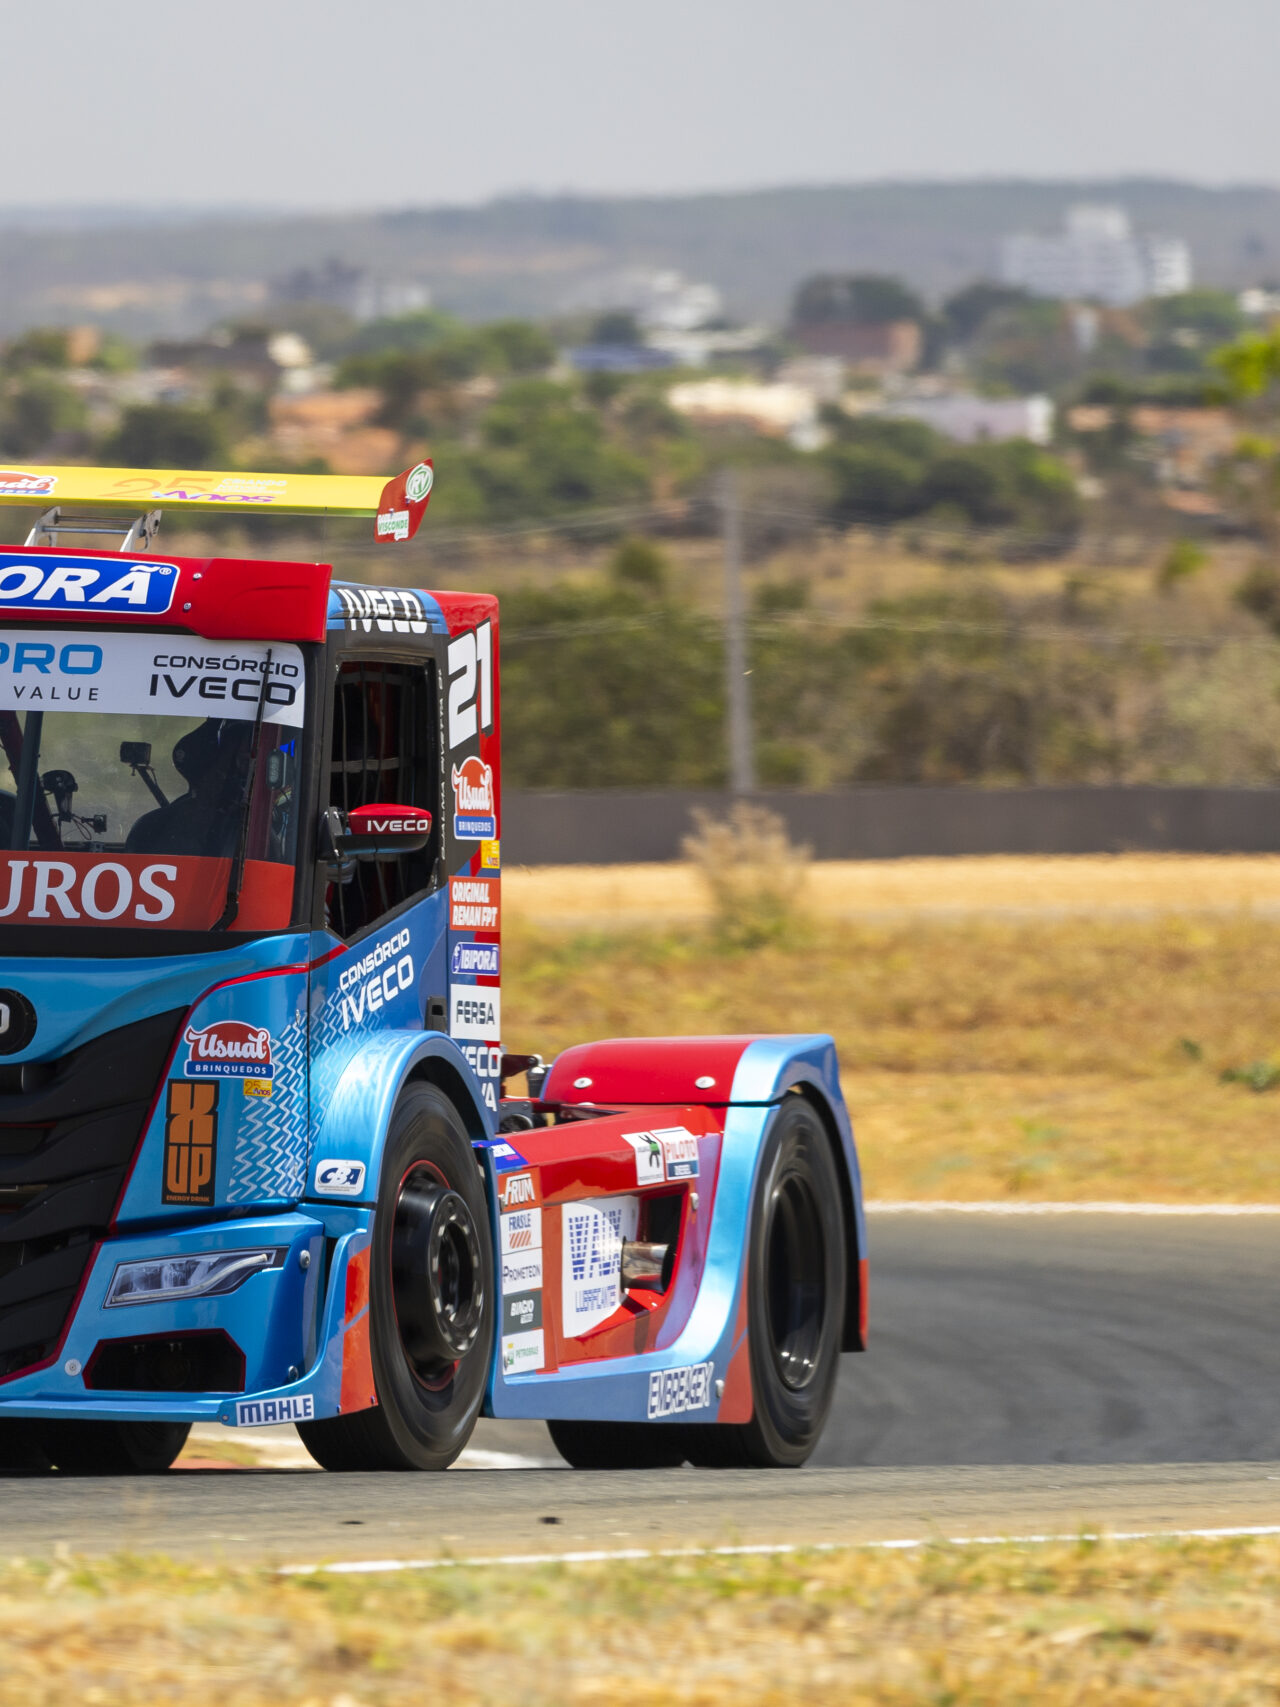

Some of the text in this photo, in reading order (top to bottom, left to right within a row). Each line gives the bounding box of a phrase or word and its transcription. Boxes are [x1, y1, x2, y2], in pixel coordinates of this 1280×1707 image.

[101, 477, 194, 499] 25
[338, 588, 428, 634] IVECO
[153, 655, 299, 678] CONSÓRCIO
[13, 685, 99, 701] VALUE
[149, 673, 297, 706] IVECO
[447, 620, 492, 751] 21
[453, 767, 491, 811] Usual
[367, 819, 428, 832] IVECO
[458, 821, 492, 834] BRINQUEDOS
[452, 881, 490, 904] ORIGINAL
[452, 904, 498, 927] REMAN FPT
[339, 927, 410, 990] CONSÓRCIO
[460, 946, 497, 971] IBIPORÃ
[341, 954, 414, 1032] IVECO
[456, 1000, 496, 1026] FERSA
[188, 1030, 267, 1060] Usual
[195, 1063, 267, 1075] BRINQUEDOS
[244, 1080, 261, 1094] 25
[166, 1145, 212, 1194] UP
[320, 1167, 362, 1186] CBA
[504, 1173, 535, 1206] FRUM
[503, 1264, 541, 1281] PROMETEON
[239, 1397, 313, 1424] MAHLE
